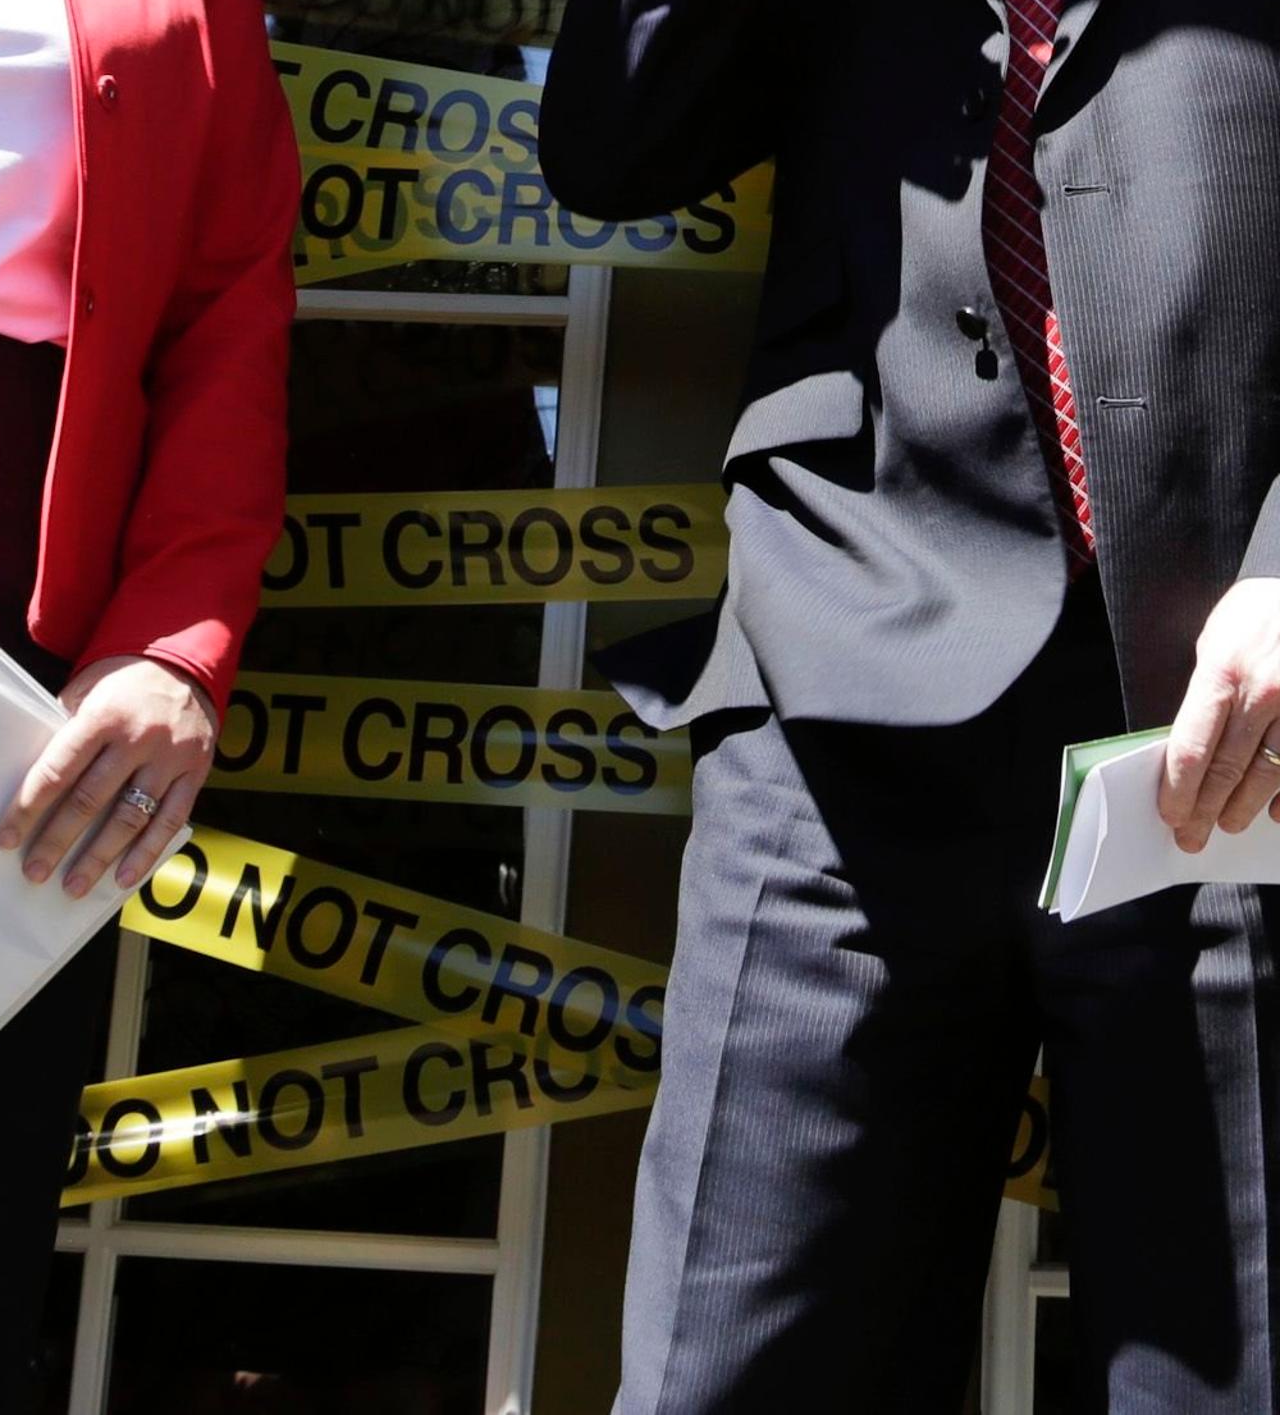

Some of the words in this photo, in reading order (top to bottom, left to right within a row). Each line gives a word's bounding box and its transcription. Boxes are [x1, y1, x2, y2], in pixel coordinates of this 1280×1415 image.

[309, 68, 541, 172] CROS
[300, 163, 420, 241] OT
[262, 511, 361, 590] OT
[381, 503, 695, 588] CROSS
[213, 691, 327, 775] OT
[341, 696, 660, 796] CROSS
[219, 862, 418, 987] NOT
[422, 927, 665, 1074] CROS
[190, 1055, 380, 1167] NOT
